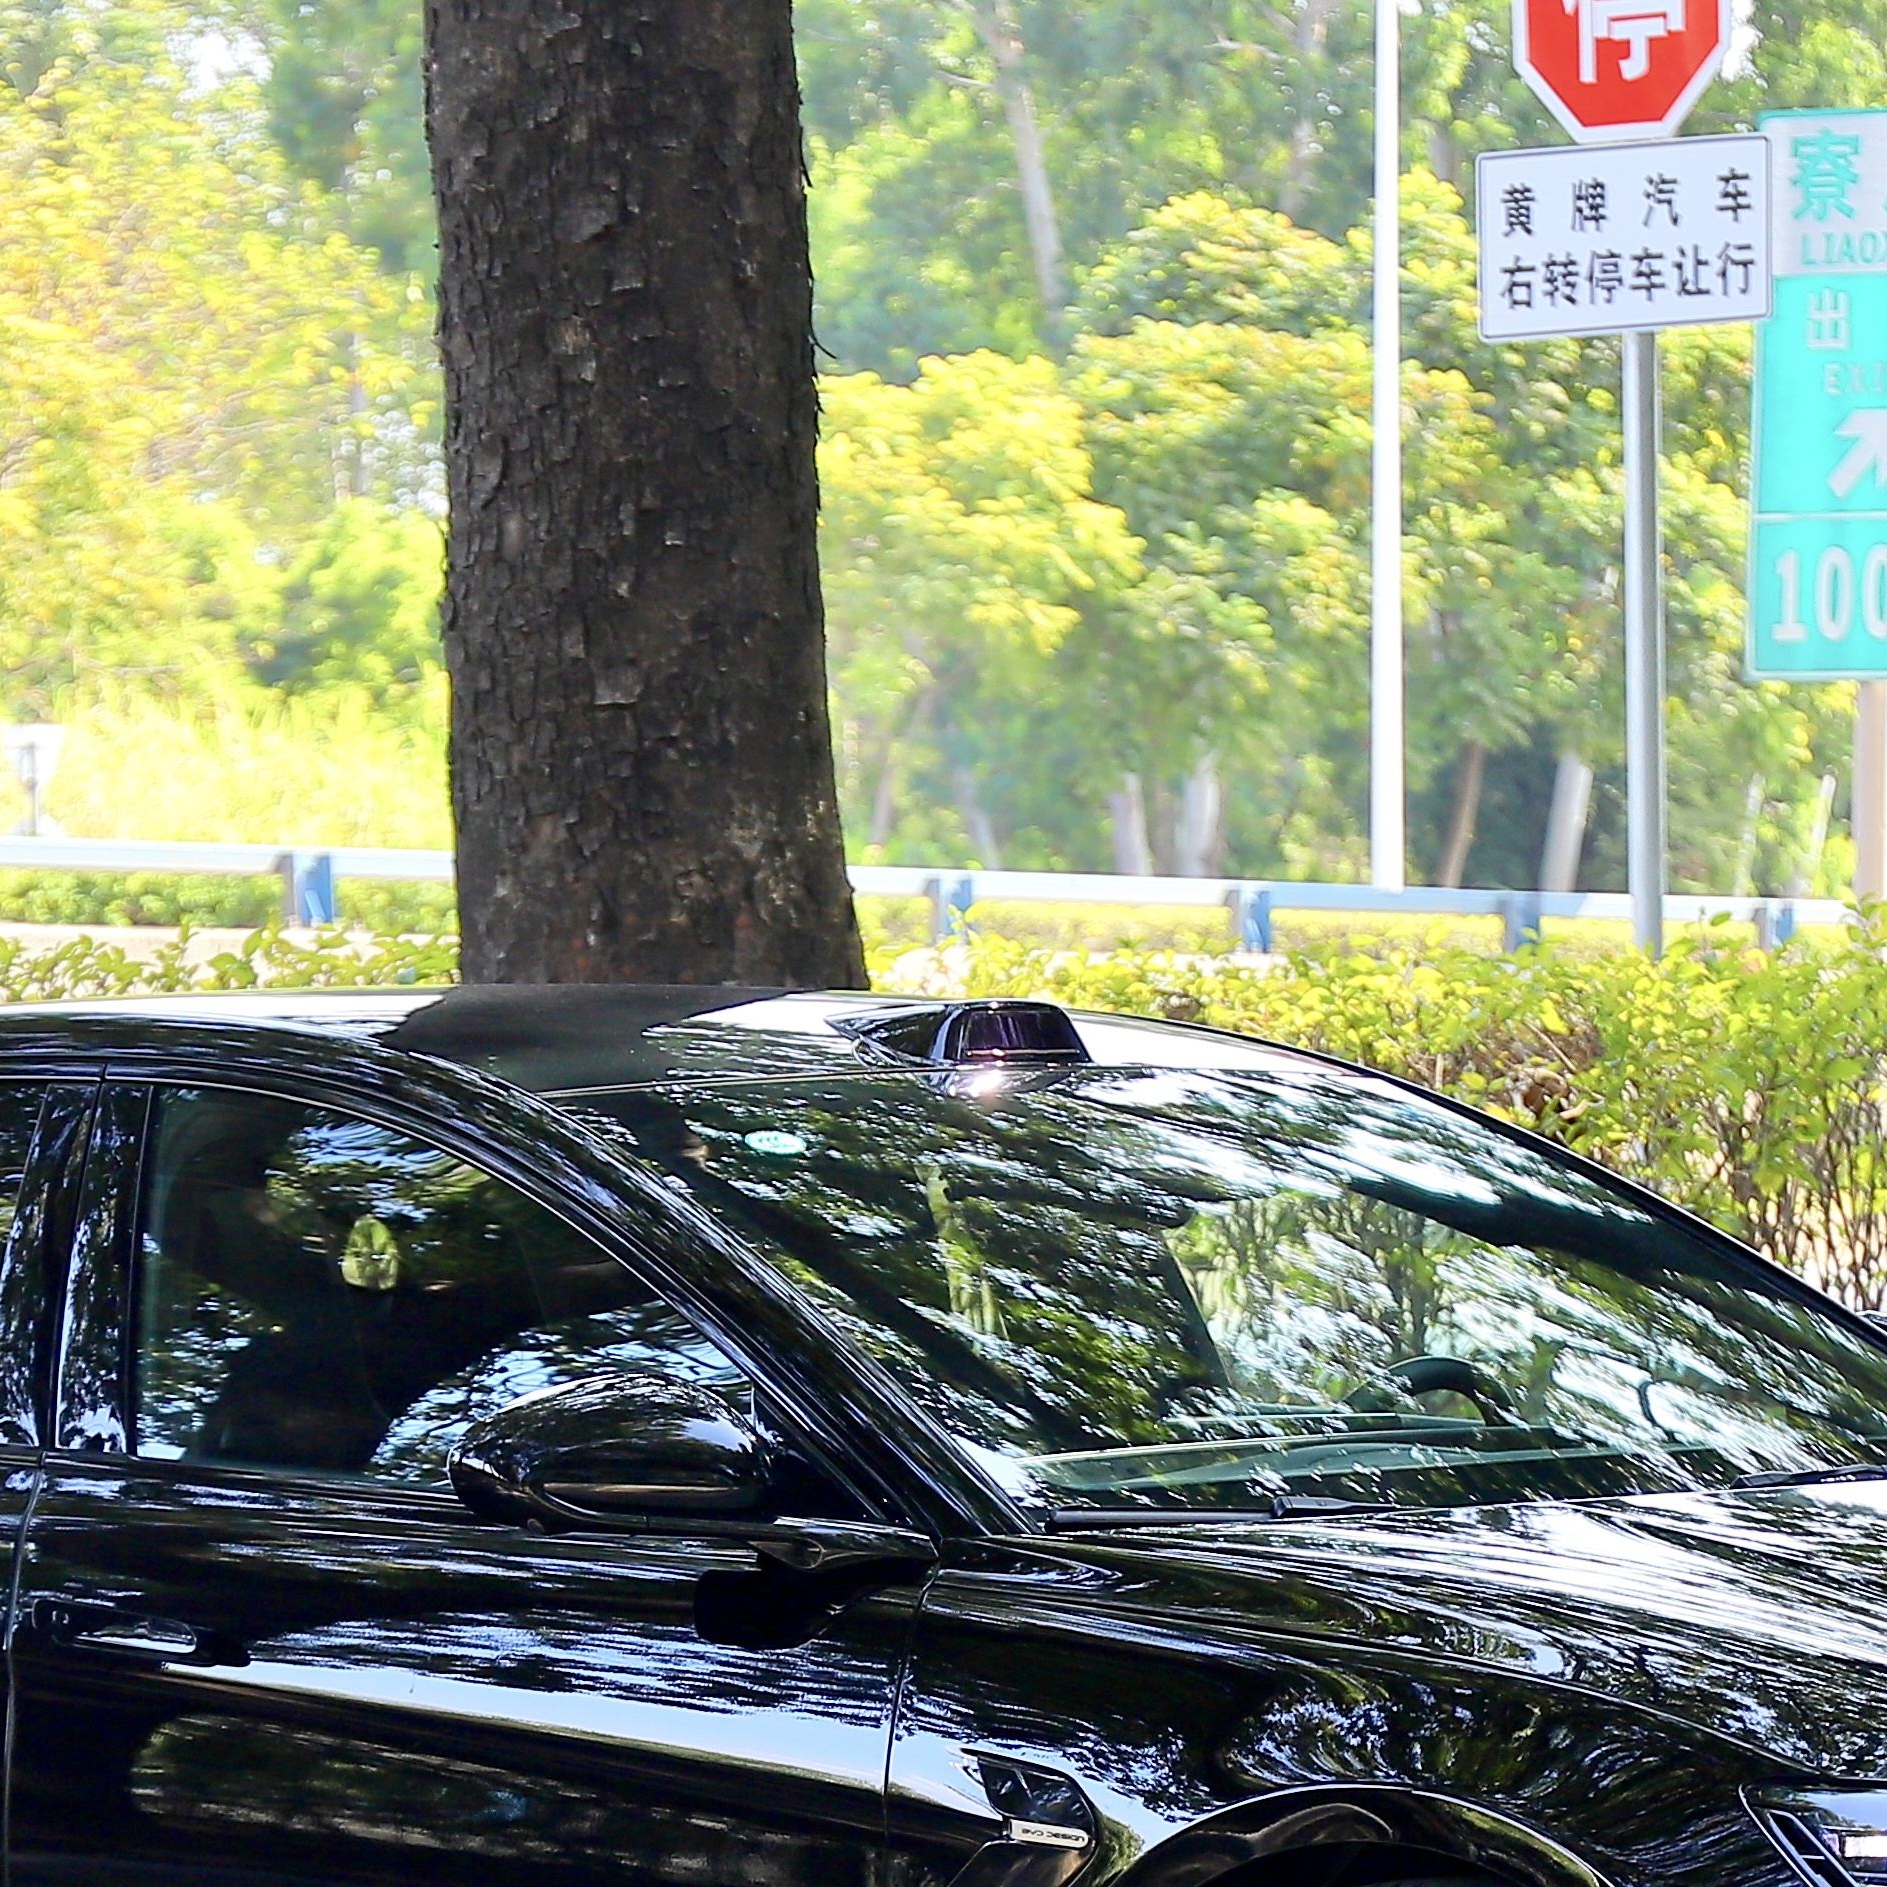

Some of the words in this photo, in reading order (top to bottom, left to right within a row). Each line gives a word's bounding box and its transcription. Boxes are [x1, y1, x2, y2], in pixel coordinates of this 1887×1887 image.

[1499, 165, 1752, 238] 黄牌汽车
[1499, 240, 1755, 310] 右转停车让行
[1022, 1828, 1044, 1838] BYD
[1045, 1831, 1085, 1843] DESIGN
